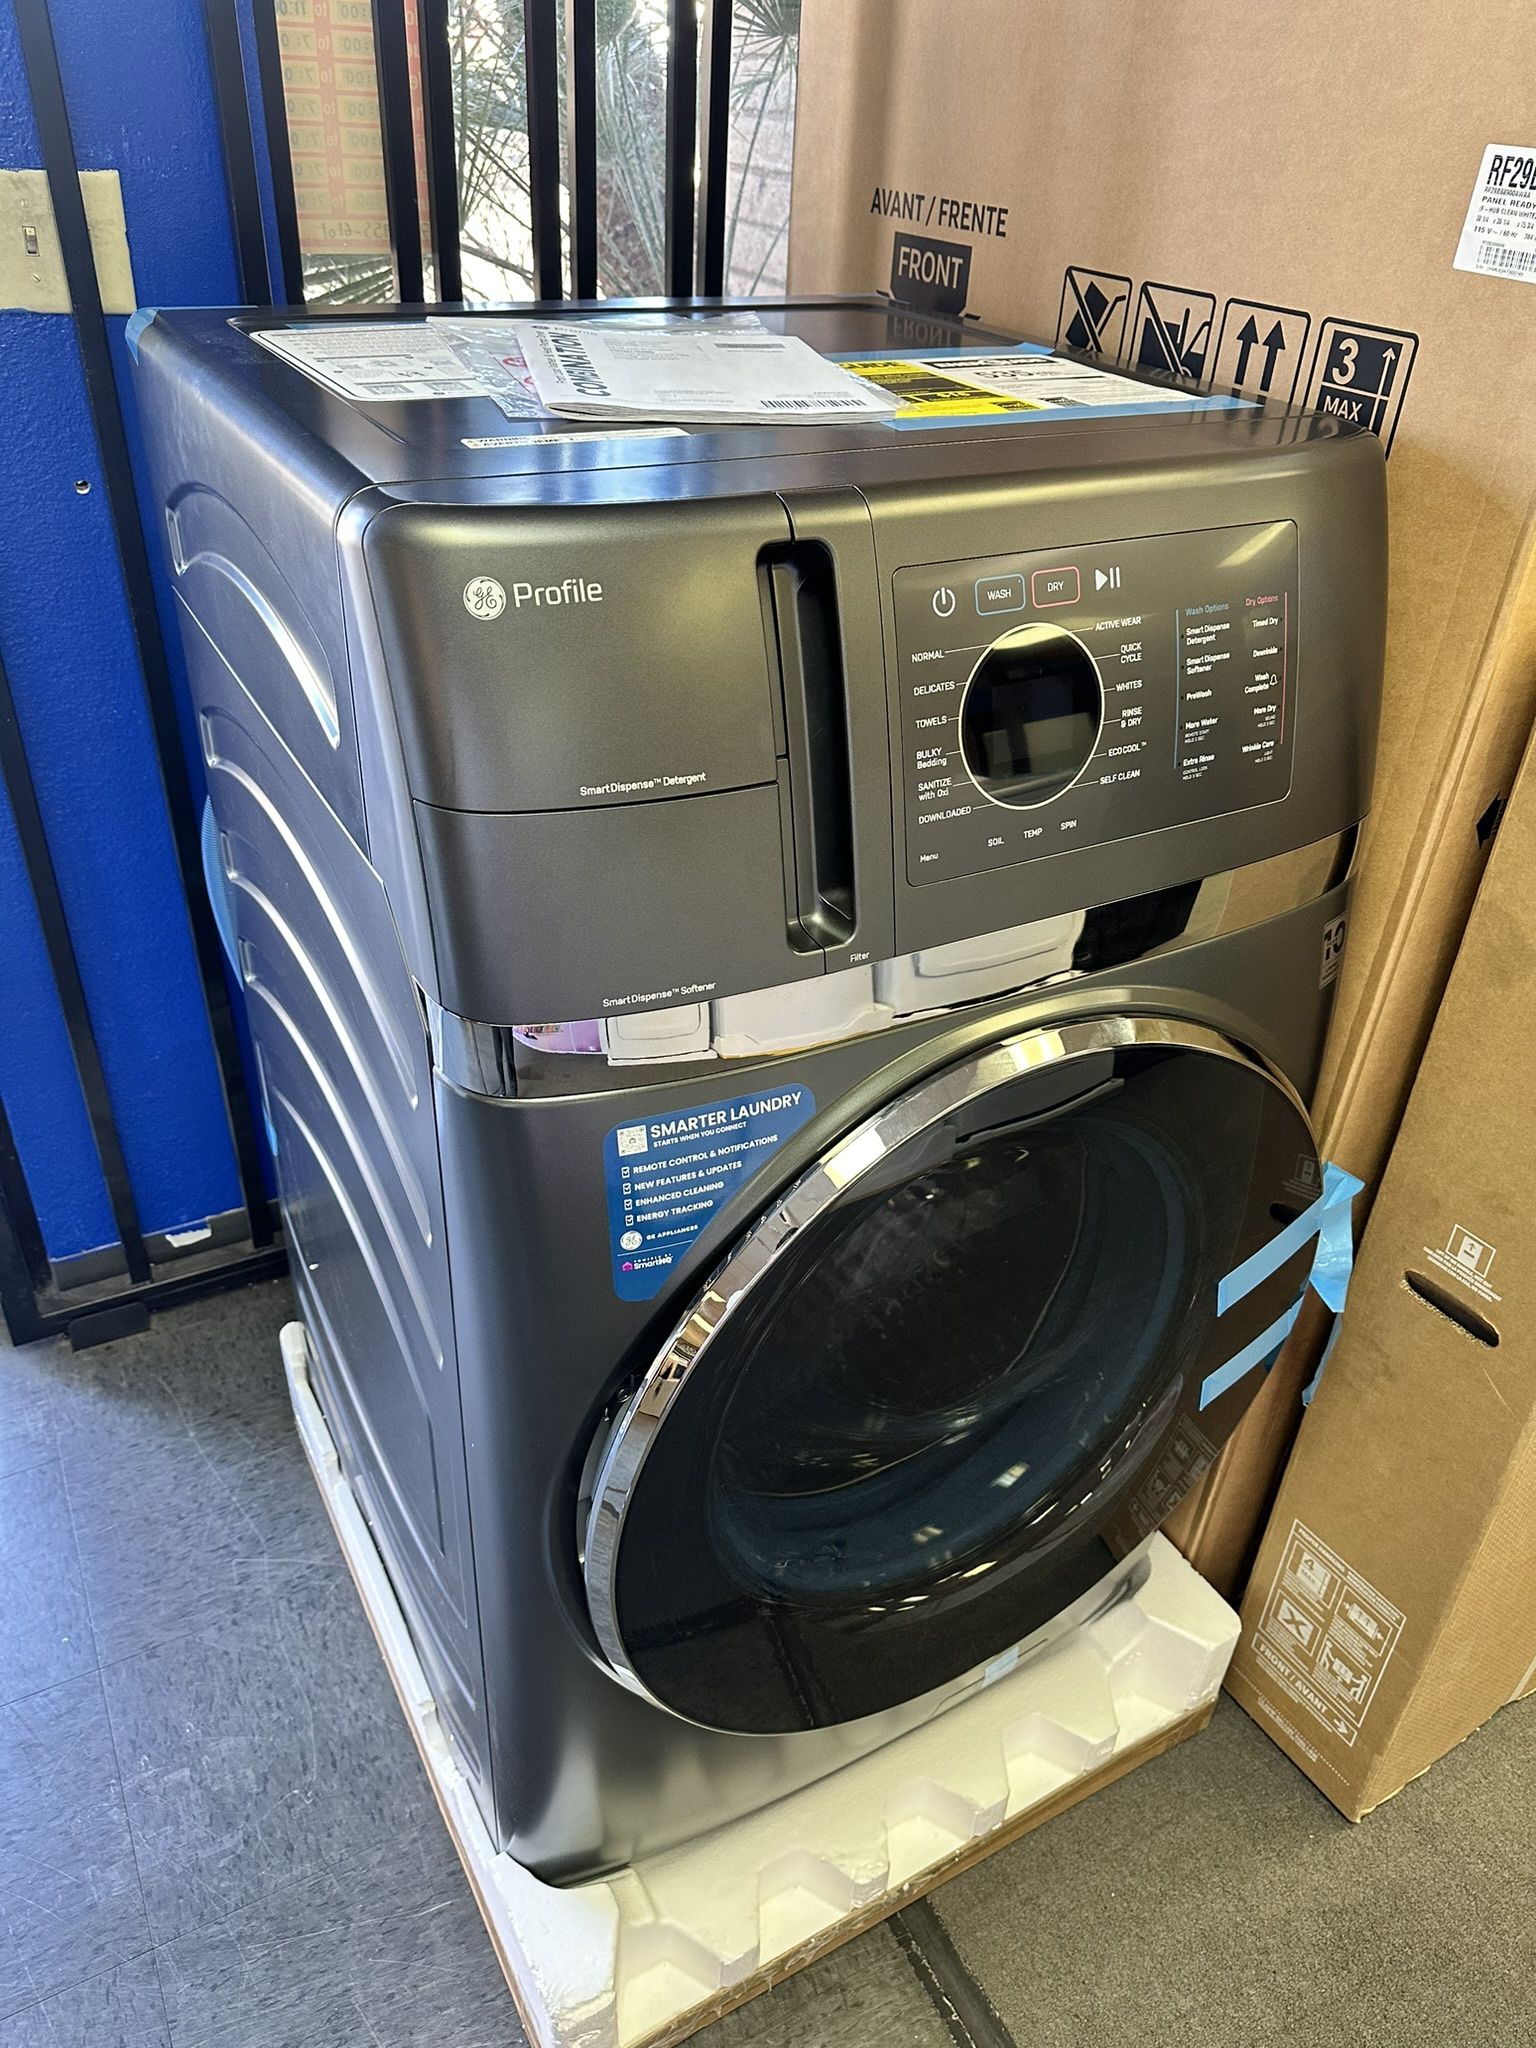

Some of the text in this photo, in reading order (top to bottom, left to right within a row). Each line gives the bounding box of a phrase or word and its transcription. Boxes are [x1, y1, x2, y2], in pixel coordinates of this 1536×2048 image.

[1482, 196, 1536, 209] PANEL READY
[871, 187, 1009, 238] AVANT / FRENTE
[898, 246, 964, 289] FRONT
[1331, 338, 1359, 386] 3
[1323, 398, 1362, 423] MAX
[513, 578, 603, 608] Profile
[987, 581, 1064, 601] WASH DRY
[1246, 595, 1278, 607] Dry Options
[1186, 603, 1229, 616] Wash Options
[1095, 616, 1141, 631] ACTIVE WEAR
[1252, 617, 1279, 628] Timed Dry
[1187, 634, 1216, 645] Detergent
[1121, 642, 1142, 654] QUICK
[912, 650, 945, 663] NORMAL
[1121, 653, 1142, 664] CYCLE
[1187, 665, 1213, 675] Softener
[1255, 672, 1270, 682] Wash
[914, 681, 956, 696] DELICATES
[1116, 680, 1143, 692] WHITES
[1245, 683, 1270, 694] Complete
[1186, 690, 1213, 701] PreWash
[1122, 706, 1143, 718] RINSE
[1254, 705, 1277, 715] More Dry
[916, 715, 947, 729] TOWELS
[1128, 717, 1143, 727] DRY
[1186, 718, 1219, 730] More Water
[1242, 740, 1275, 753] Wrinkle Care
[916, 748, 943, 760] BULKY
[917, 757, 947, 770] Bedding
[1183, 755, 1215, 767] Extra Rinse
[663, 772, 707, 786] Detergent
[1100, 769, 1141, 785] SELF CLEAN
[918, 777, 952, 792] SANITIZE
[919, 788, 950, 802] with Oxi
[918, 806, 972, 825] DOWNLOADED
[1060, 820, 1078, 831] SPIN
[1024, 828, 1044, 839] TEMP
[988, 837, 1005, 847] SOIL
[920, 853, 939, 863] Menu
[850, 952, 870, 963] Filter
[681, 982, 717, 995] Softener
[650, 1092, 802, 1138] SMARTER LAUNDRY
[653, 1121, 747, 1148] STARTS WHEN YOU CONNECT
[633, 1134, 779, 1175] REMOTE CONTROL & NOTIFICATIONS
[634, 1161, 743, 1191] NEW FEATURES & UPDATES
[636, 1181, 725, 1207] ENHANCED CLEANING
[637, 1200, 714, 1223] ENERGY TRACKING
[657, 1224, 699, 1239] APPLIANCES
[634, 1257, 673, 1270] SmartHQ
[1304, 1558, 1315, 1571] 4
[1260, 1644, 1291, 1676] FRONT
[1295, 1680, 1328, 1713] AVANT
